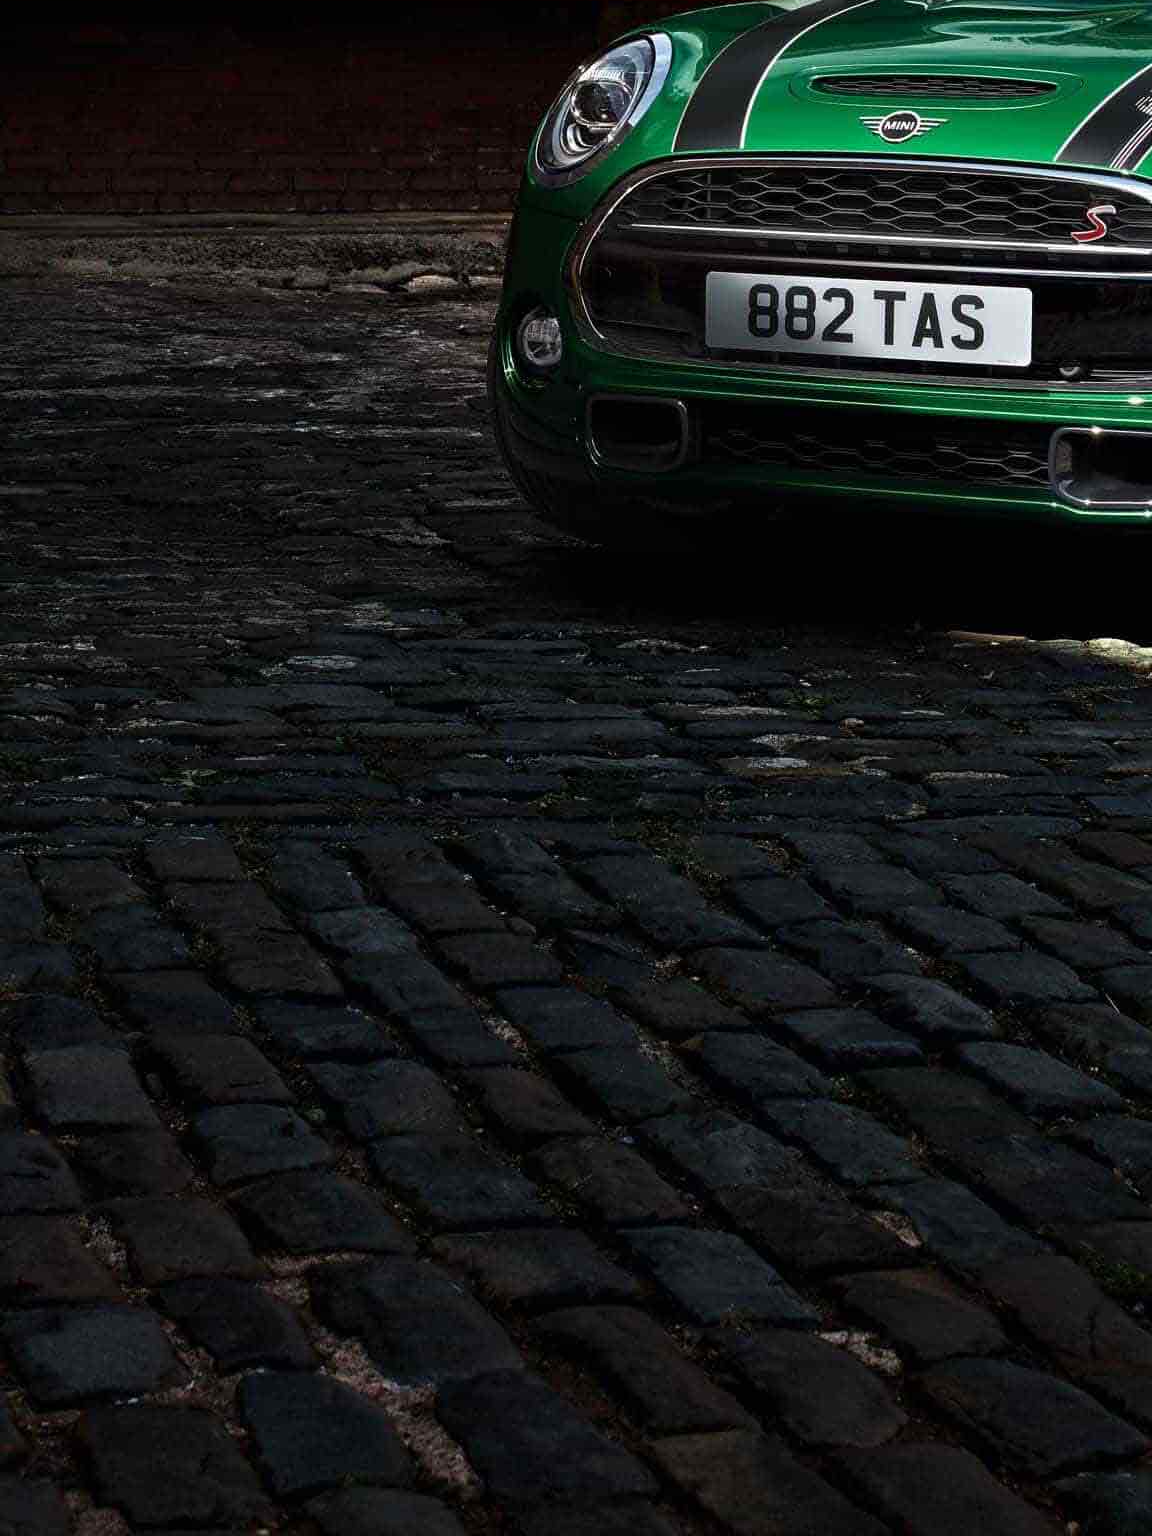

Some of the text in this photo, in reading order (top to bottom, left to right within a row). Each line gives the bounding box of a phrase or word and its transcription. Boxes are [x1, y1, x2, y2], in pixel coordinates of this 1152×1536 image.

[883, 120, 915, 131] MINI
[1070, 204, 1117, 243] S
[749, 283, 986, 351] 882 TAS
